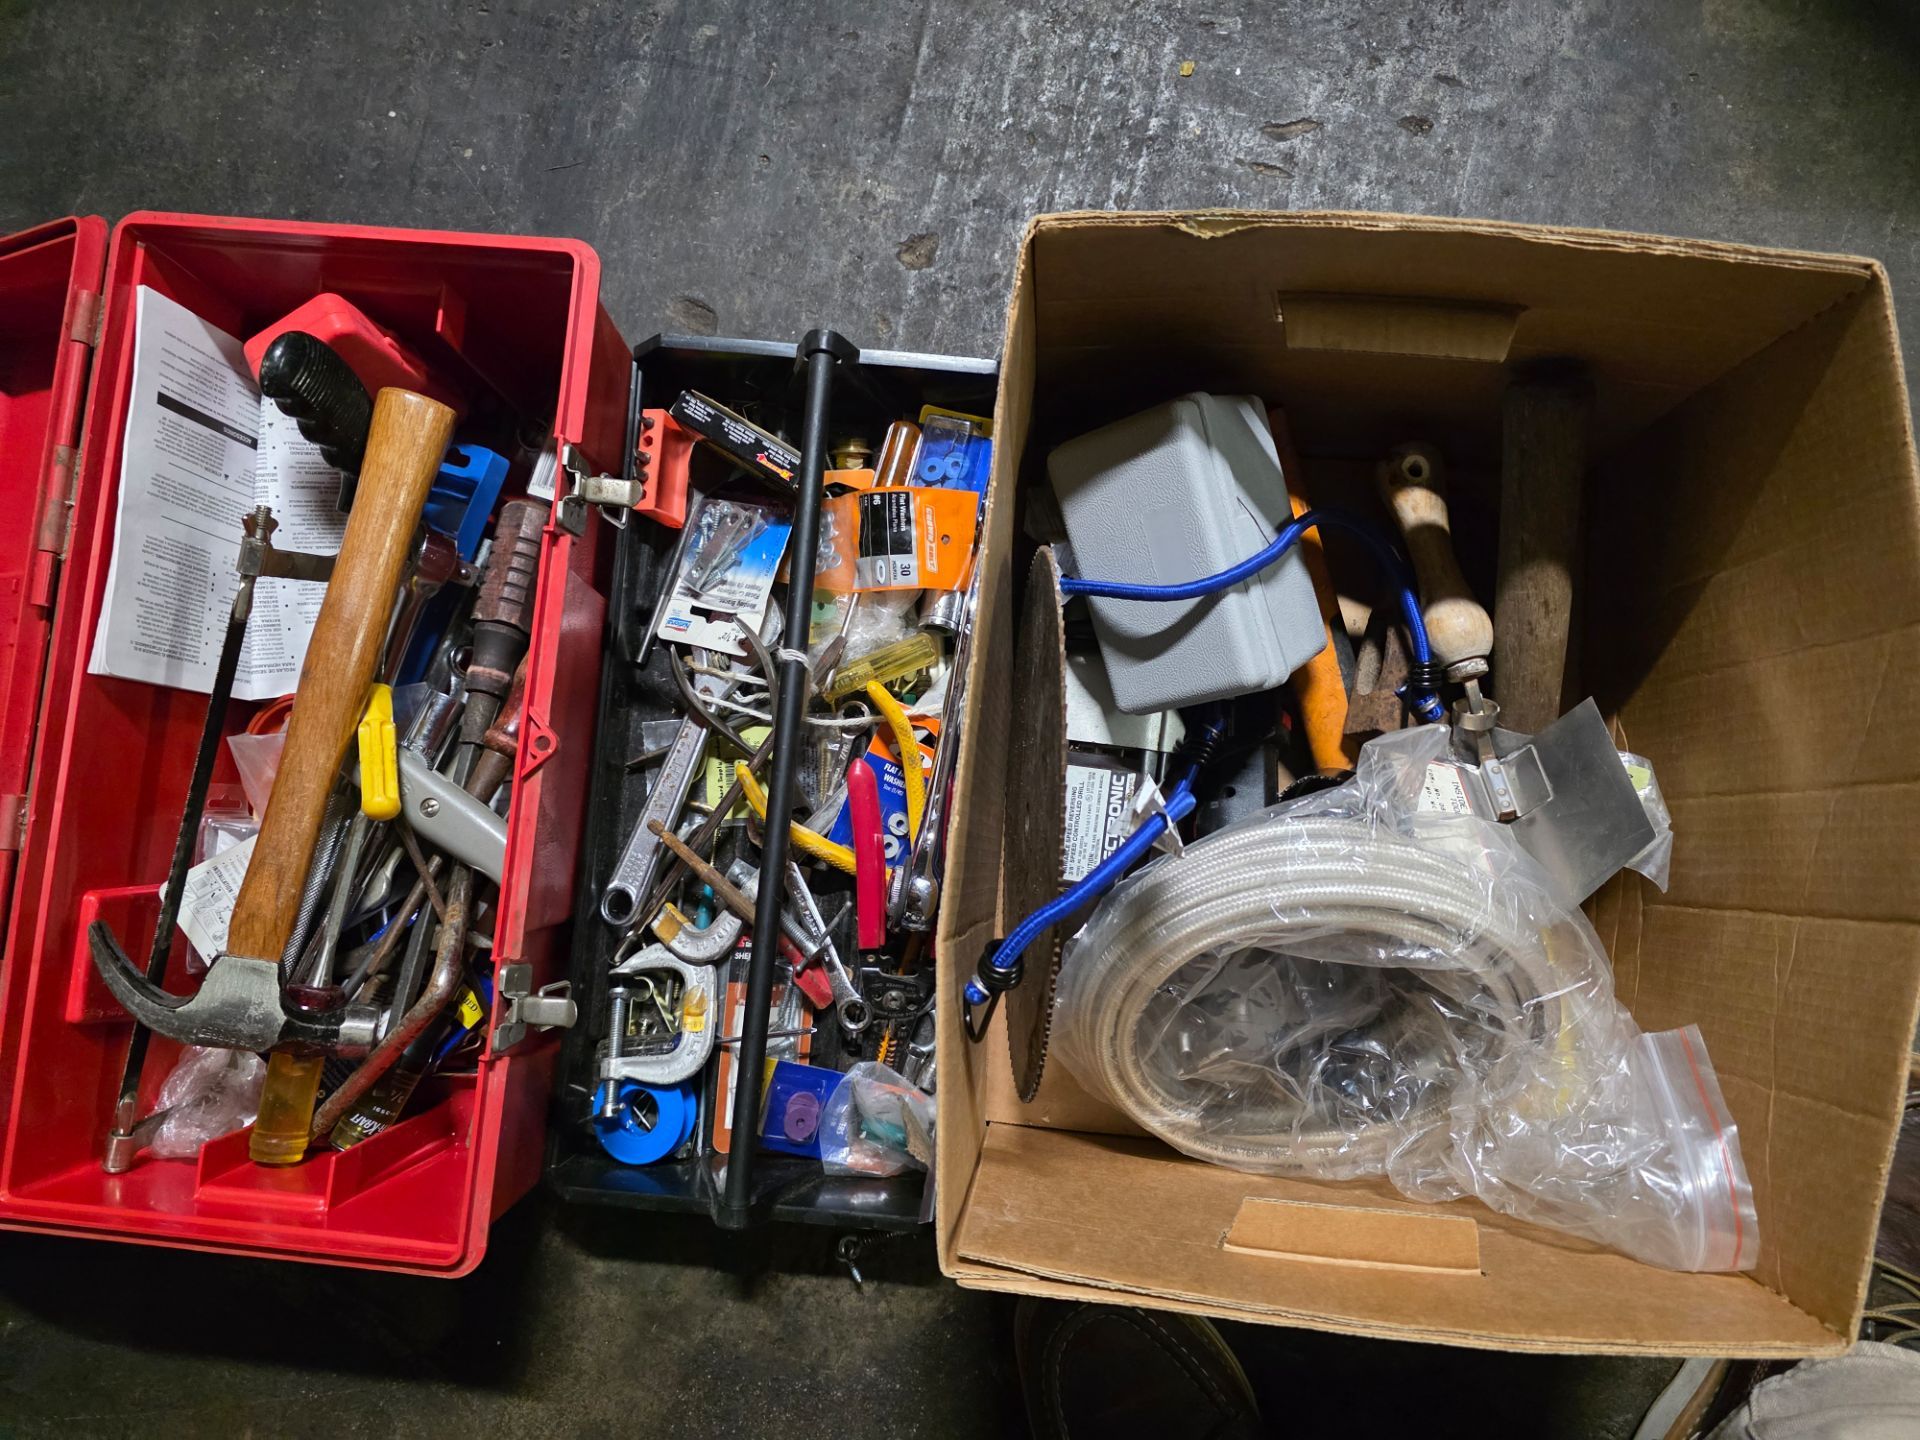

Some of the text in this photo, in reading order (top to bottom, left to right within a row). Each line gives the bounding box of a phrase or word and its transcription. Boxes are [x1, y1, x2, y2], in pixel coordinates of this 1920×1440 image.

[871, 494, 881, 505] #6
[899, 562, 911, 576] 30
[883, 762, 898, 774] FLAT
[1076, 780, 1084, 799] DRILL
[1067, 786, 1077, 821] REVERSING
[1071, 800, 1082, 841] CONTROLLED
[1064, 821, 1072, 843] SPEED
[211, 863, 234, 894] INSTALLATION
